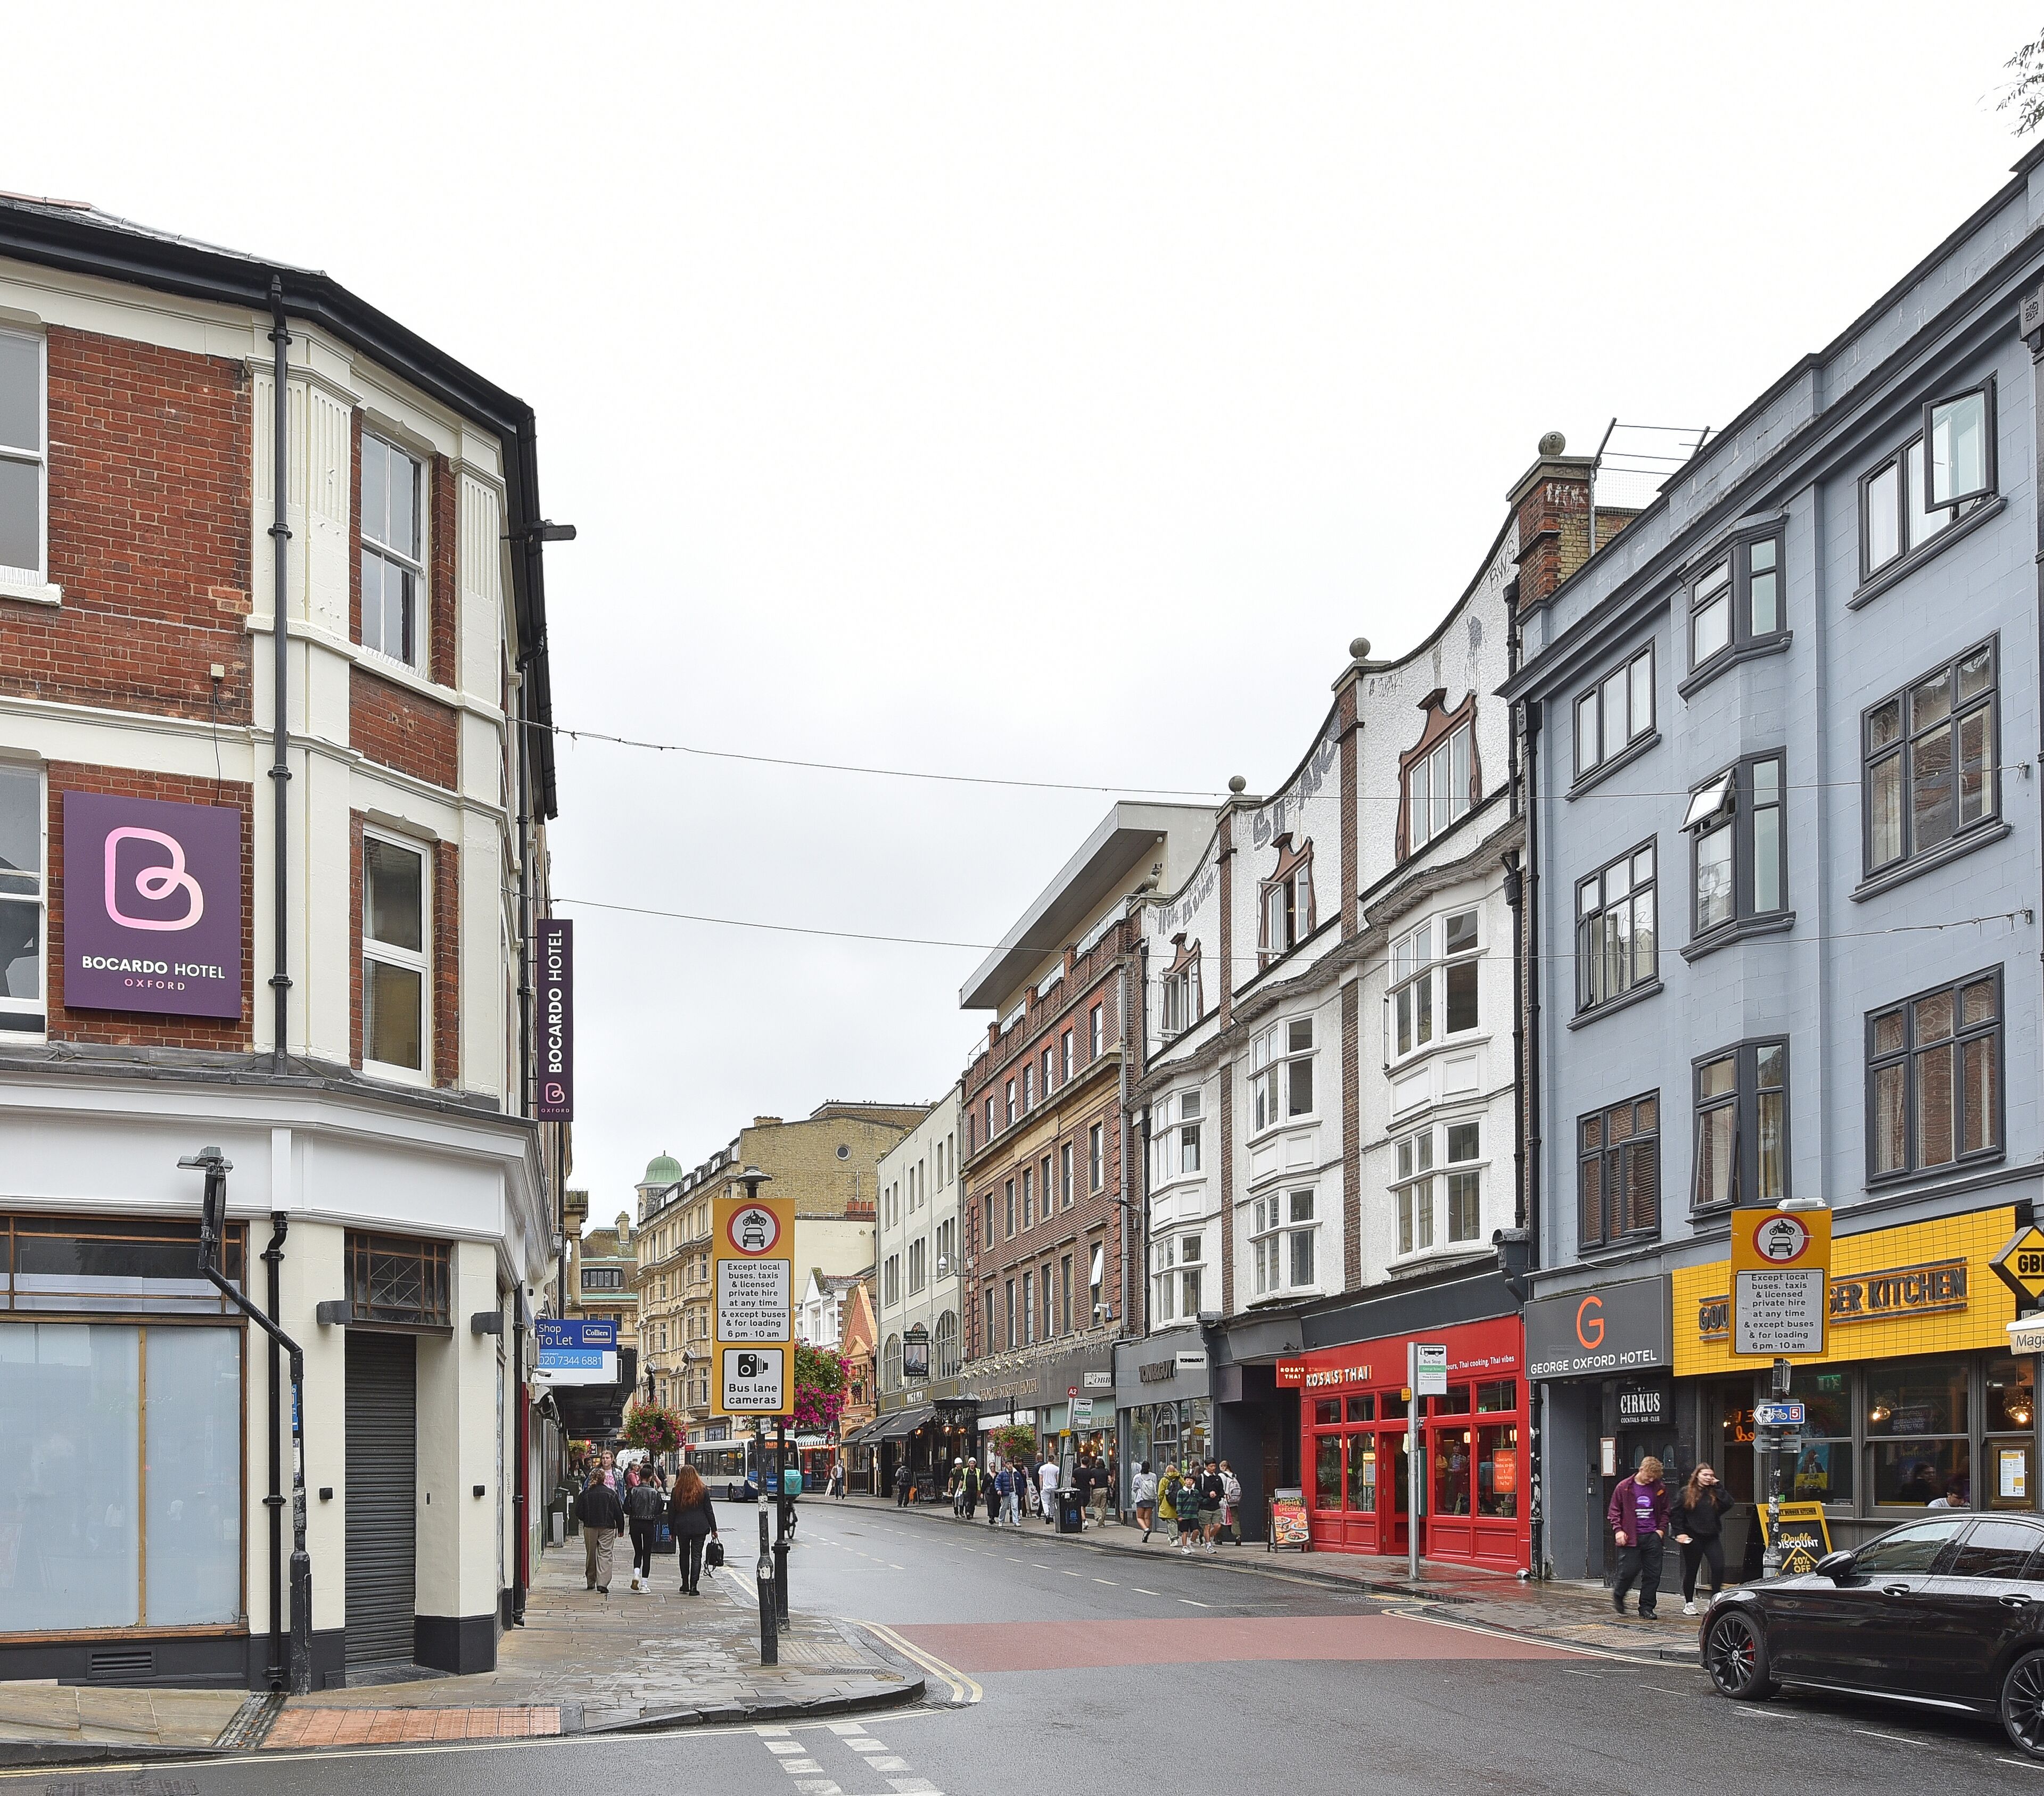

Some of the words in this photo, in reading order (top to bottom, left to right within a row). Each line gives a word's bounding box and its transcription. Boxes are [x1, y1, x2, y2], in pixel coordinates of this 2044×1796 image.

[548, 929, 562, 981] HOTEL
[82, 955, 168, 975] BOCARDO
[175, 962, 225, 979] HOTEL
[124, 978, 186, 991] OXFORD
[548, 988, 562, 1073] BOCARDO
[728, 1263, 757, 1271] Except
[1699, 1303, 1729, 1331] GOU
[1868, 1267, 1967, 1310] KITCHEN
[1576, 1295, 1605, 1349] G
[539, 1324, 561, 1335] Shop
[538, 1335, 553, 1345] To
[556, 1335, 573, 1345] Let
[2016, 1334, 2044, 1348] Mag
[558, 1356, 580, 1365] 7344
[581, 1356, 601, 1365] 6881
[1490, 1356, 1501, 1364] Thai
[1530, 1360, 1569, 1375] GEORGE
[1572, 1354, 1616, 1370] OXFORD
[1620, 1350, 1657, 1364] HOTEL
[1139, 1359, 1175, 1383] TONI&GUY
[1306, 1370, 1339, 1387] ROSA'S
[1345, 1365, 1368, 1382] THAI
[729, 1384, 749, 1392] Bus
[754, 1383, 778, 1392] lane
[979, 1386, 998, 1402] GEORGE
[1000, 1382, 1018, 1398] STREET
[1020, 1377, 1039, 1395] HOTEL
[1620, 1393, 1660, 1413] CIRKUS
[1791, 1408, 1799, 1418] 5
[1781, 1533, 1811, 1542] Double
[1792, 1556, 1810, 1565] 20%
